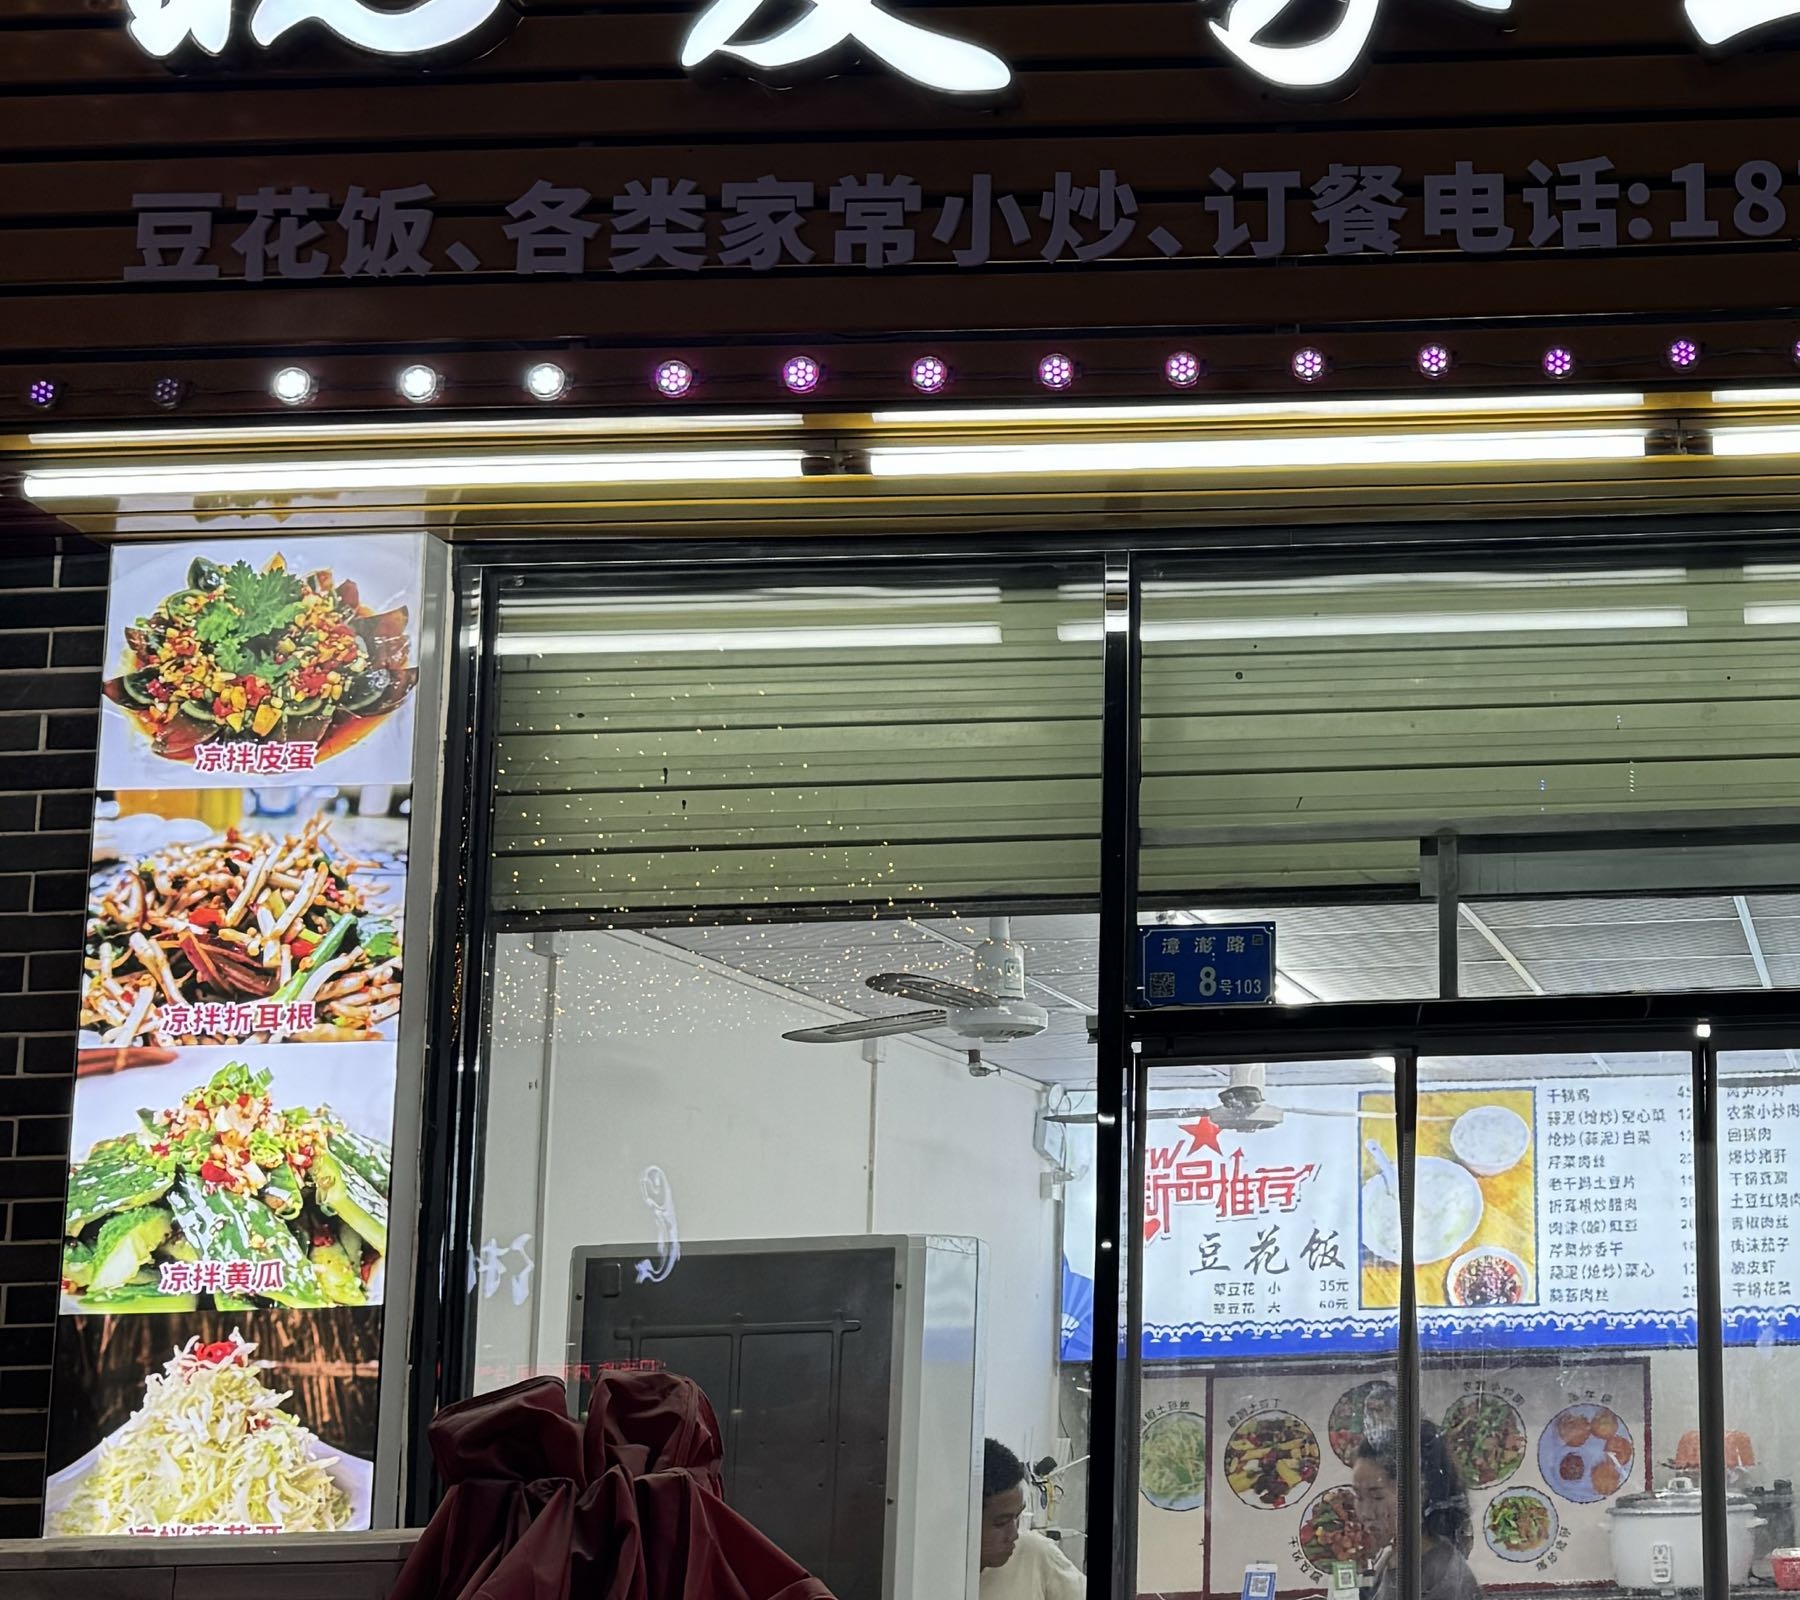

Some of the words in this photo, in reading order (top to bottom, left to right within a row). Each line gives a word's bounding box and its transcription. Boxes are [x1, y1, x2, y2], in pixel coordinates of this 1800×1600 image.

[194, 741, 319, 773] 凉拌皮蛋
[160, 1002, 316, 1035] 凉拌折耳根
[1190, 1224, 1346, 1276] 豆花饭
[159, 1260, 285, 1294] 凉拌黄瓜
[1319, 1279, 1349, 1292] 35元
